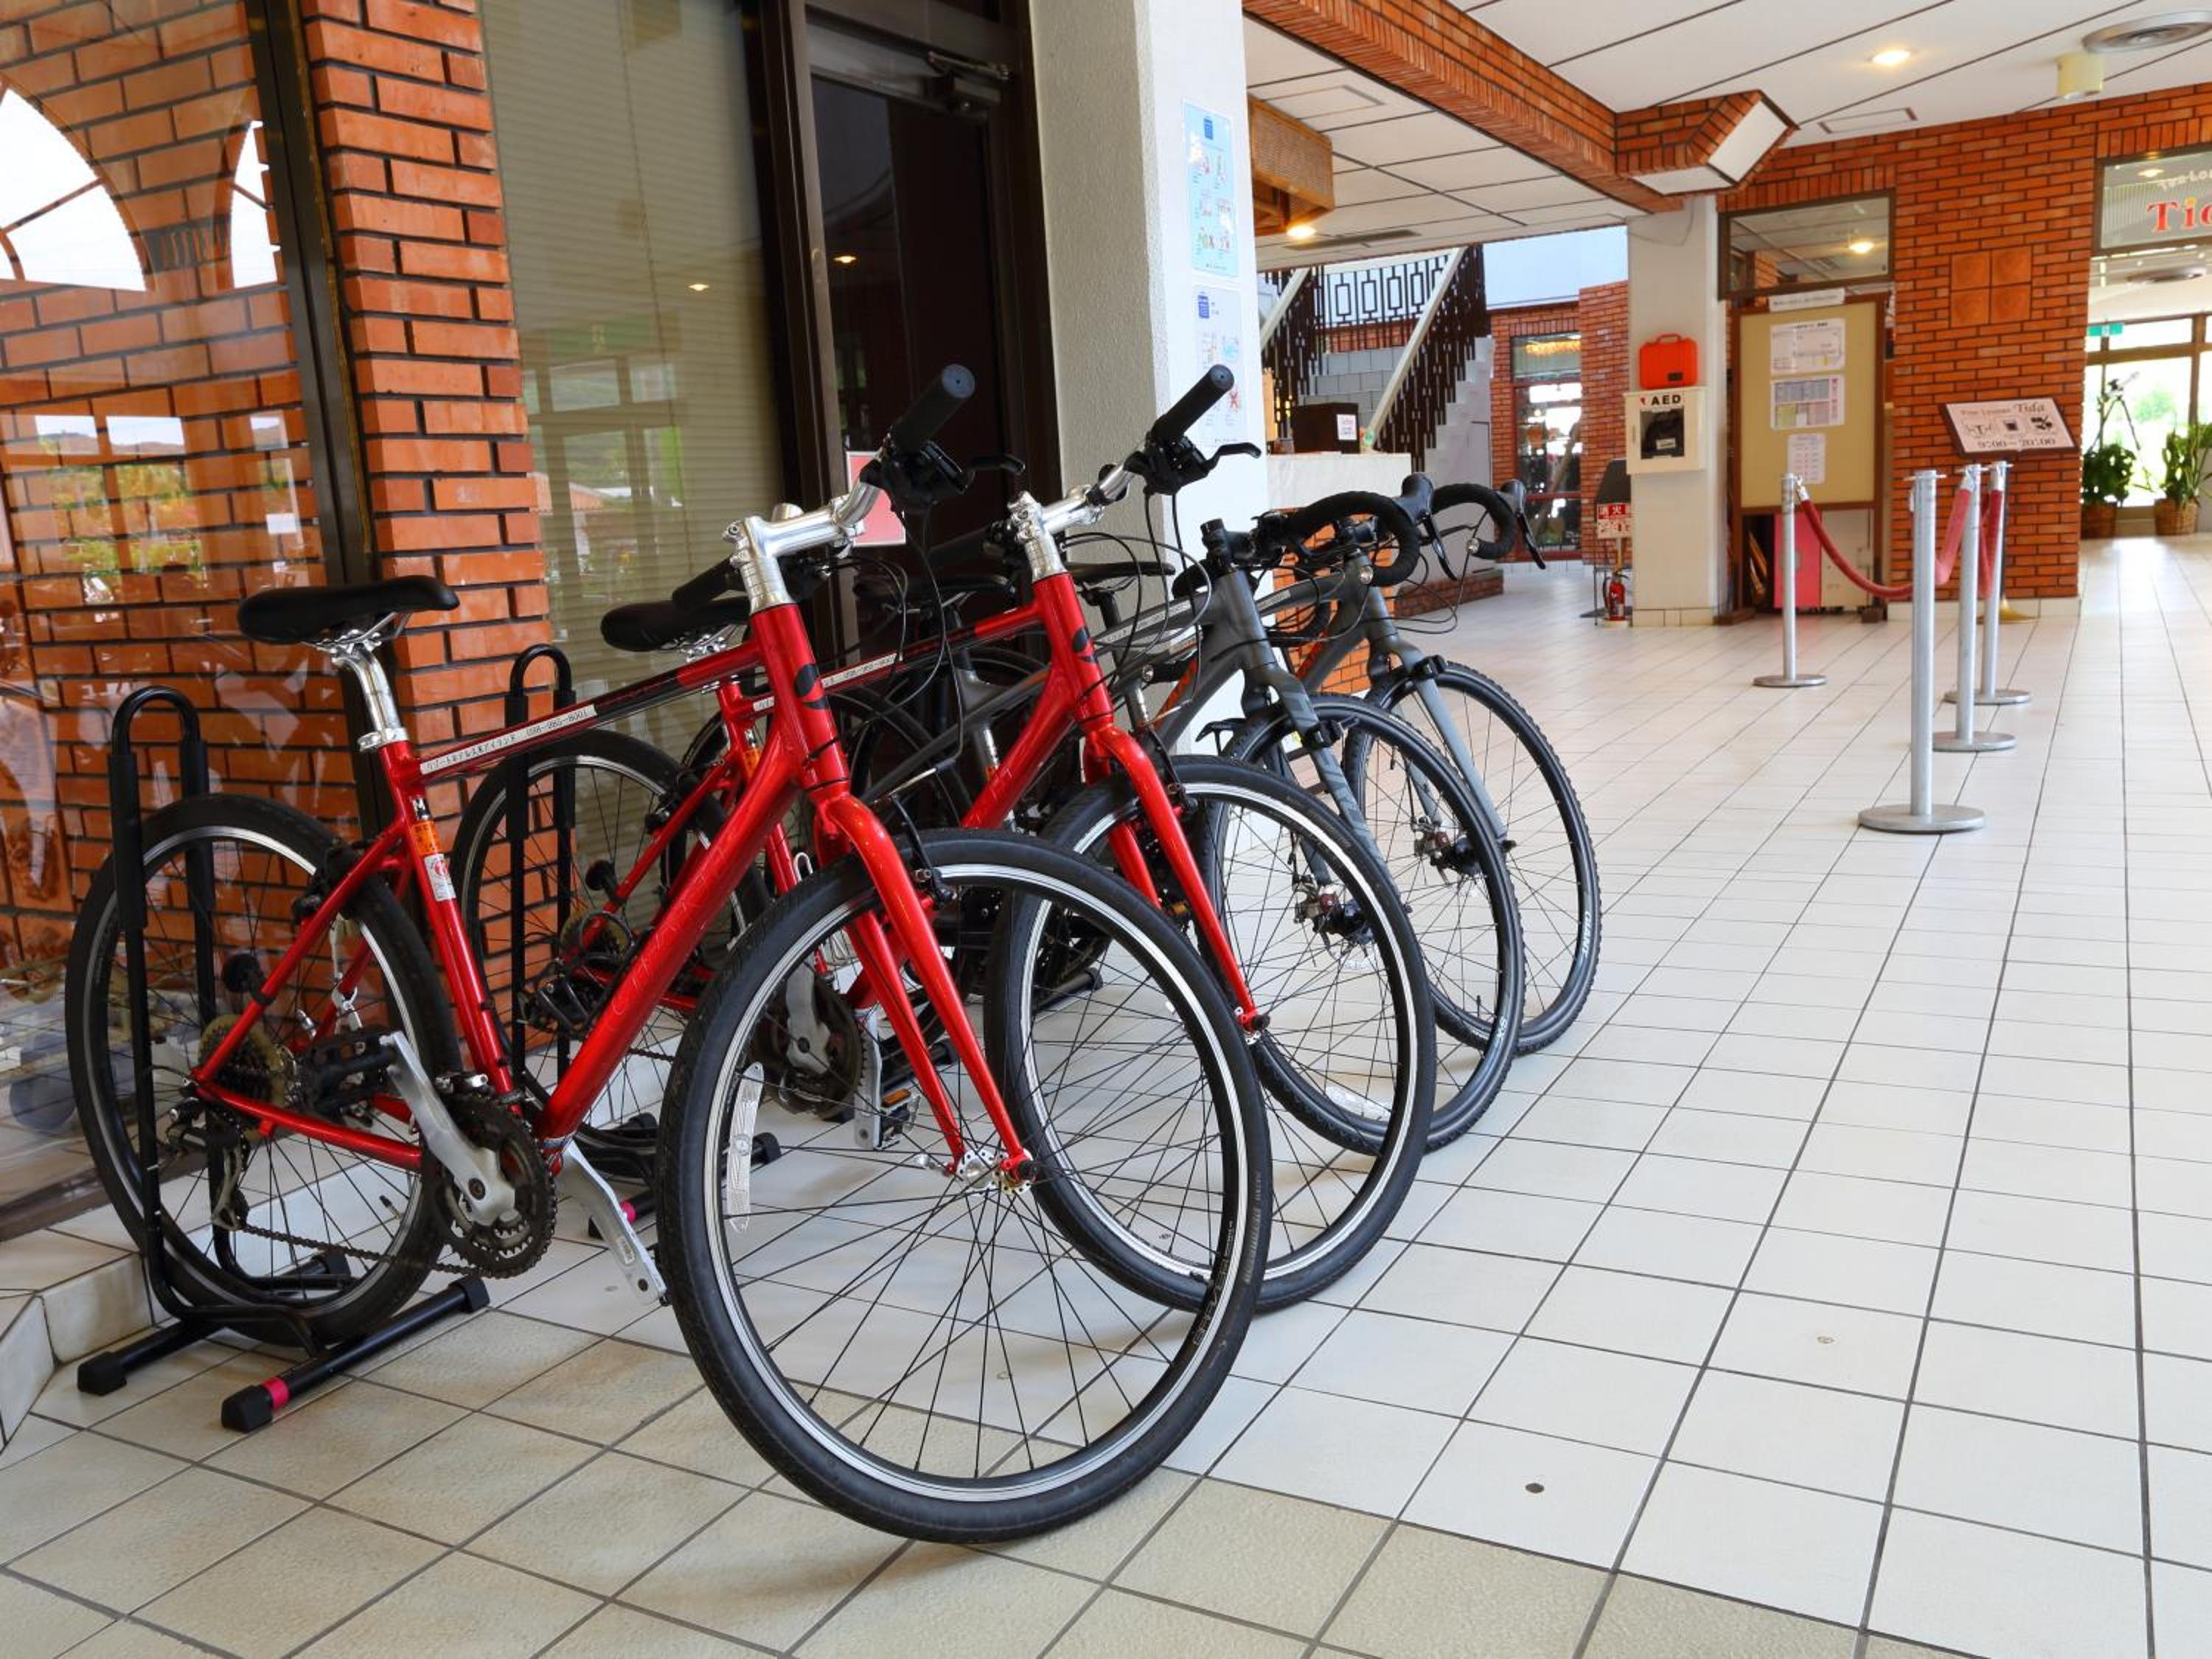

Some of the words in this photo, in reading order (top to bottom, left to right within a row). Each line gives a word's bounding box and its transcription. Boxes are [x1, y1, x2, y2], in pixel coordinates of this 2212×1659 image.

[1651, 394, 1681, 406] AED
[2017, 403, 2046, 414] Tida
[1582, 911, 1593, 957] GIANT
